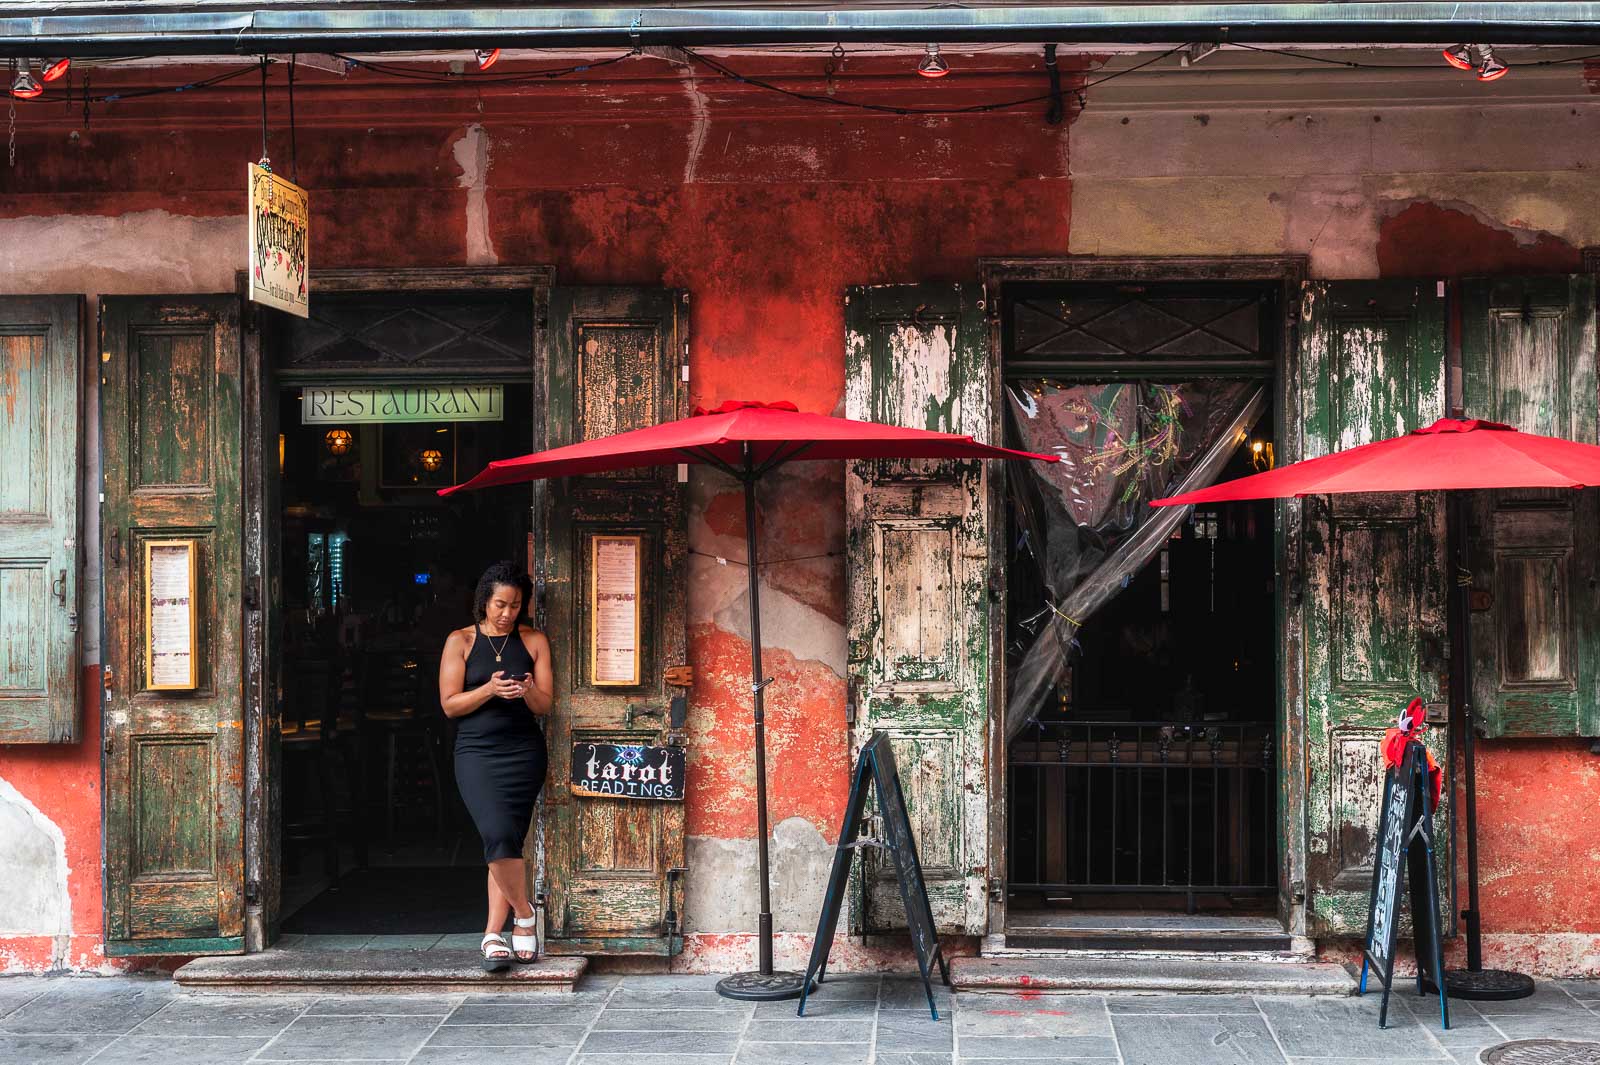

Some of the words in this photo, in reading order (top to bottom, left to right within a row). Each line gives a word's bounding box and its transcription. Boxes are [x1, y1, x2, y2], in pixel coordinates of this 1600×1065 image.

[256, 204, 306, 298] APOTHECARY
[310, 387, 500, 417] RESTAURANT
[586, 744, 673, 785] tarot
[580, 780, 674, 797] READINGS
